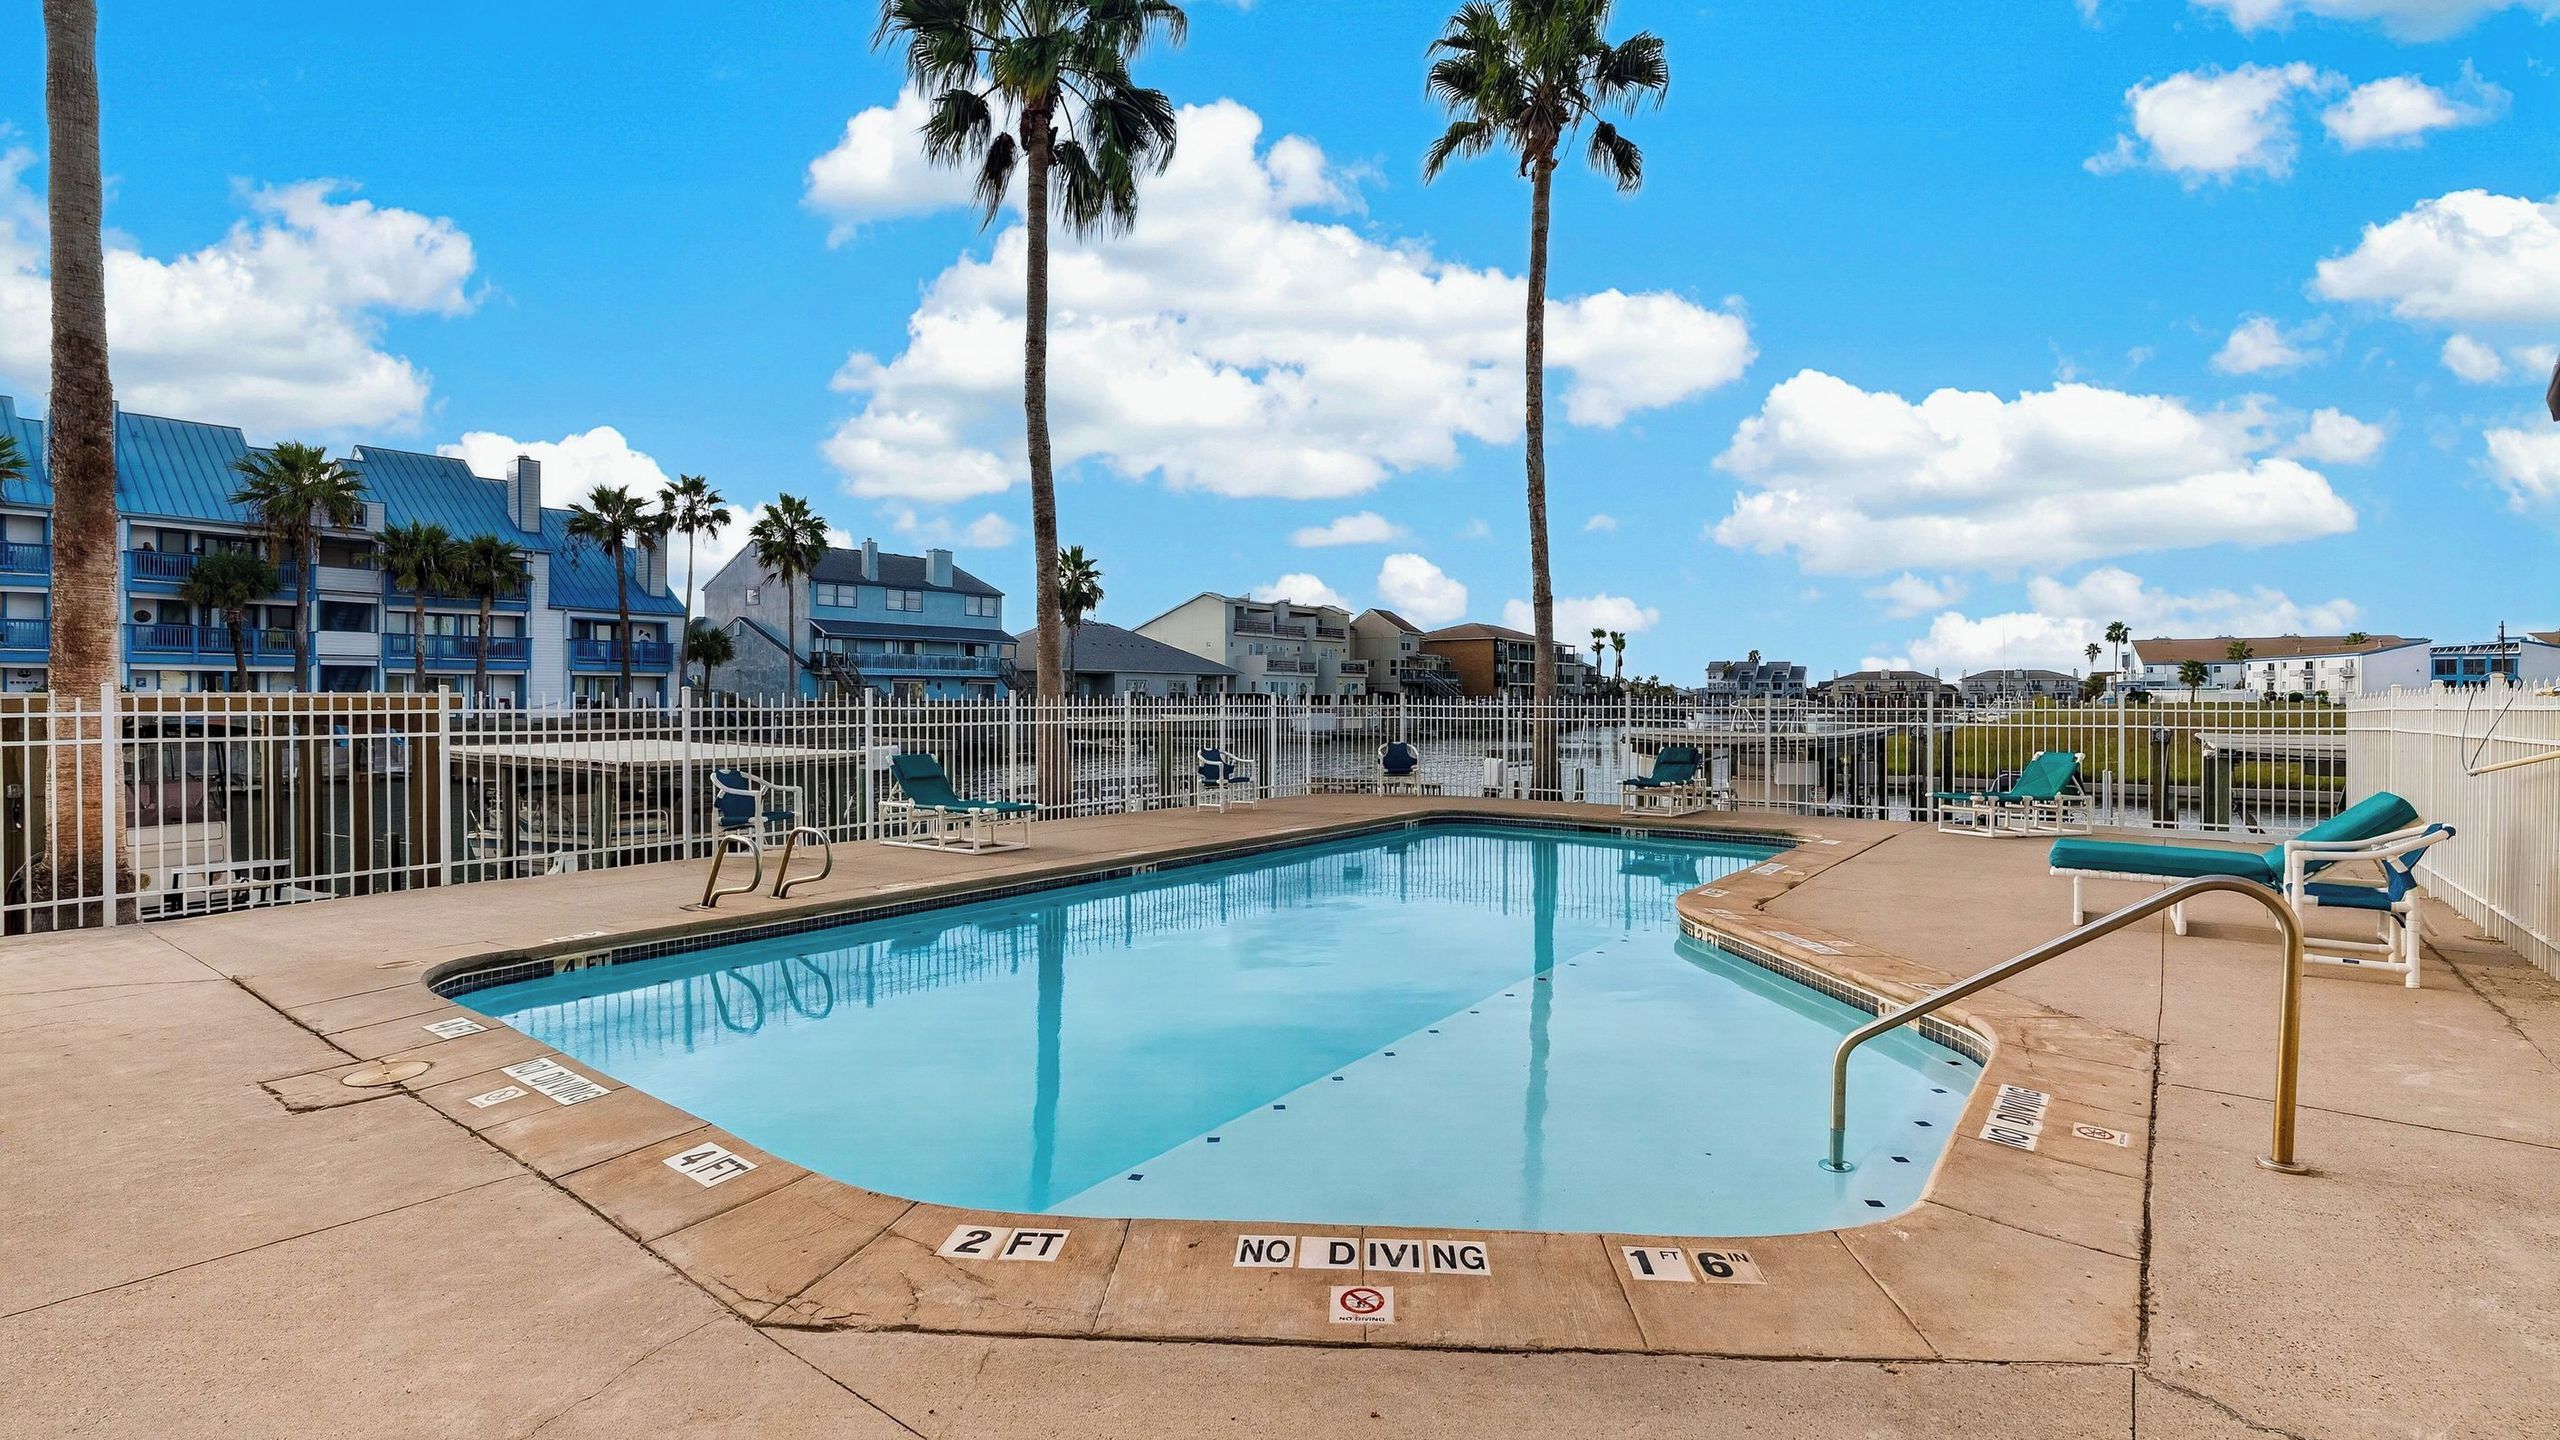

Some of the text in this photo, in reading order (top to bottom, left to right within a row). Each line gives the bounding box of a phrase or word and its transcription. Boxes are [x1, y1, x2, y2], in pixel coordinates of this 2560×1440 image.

[587, 953, 610, 970] FT
[1987, 1086, 2043, 1149] NO DIVING
[680, 1151, 749, 1181] 4 FT
[953, 1230, 1064, 1256] 2 FT
[1239, 1239, 1291, 1263] NO
[1629, 1250, 1749, 1278] 1 FT 6 IN
